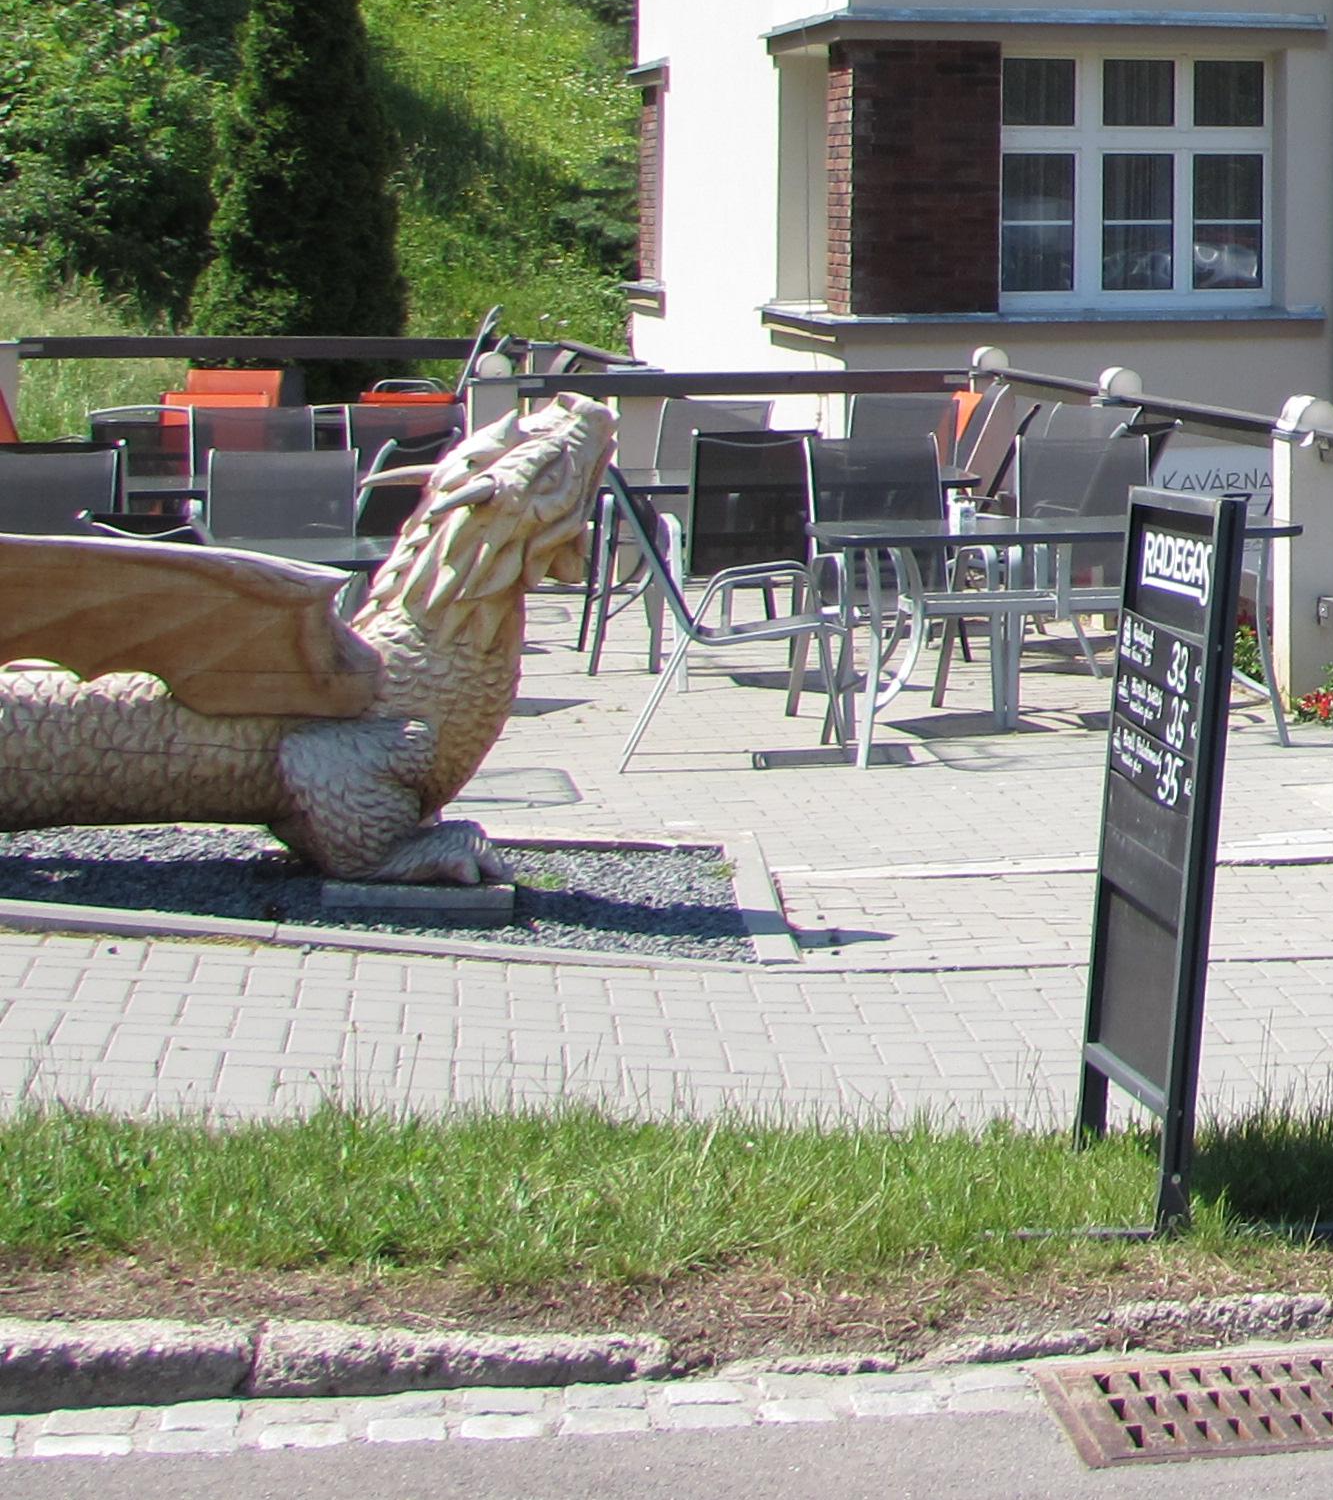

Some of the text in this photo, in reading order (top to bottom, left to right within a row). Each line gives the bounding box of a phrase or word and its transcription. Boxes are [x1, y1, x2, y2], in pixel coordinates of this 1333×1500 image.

[1162, 467, 1274, 491] KAVÁRNA
[1141, 531, 1214, 607] RADEGAS
[1166, 640, 1190, 694] 33
[1166, 695, 1190, 750] 35
[1157, 752, 1185, 806] 35
